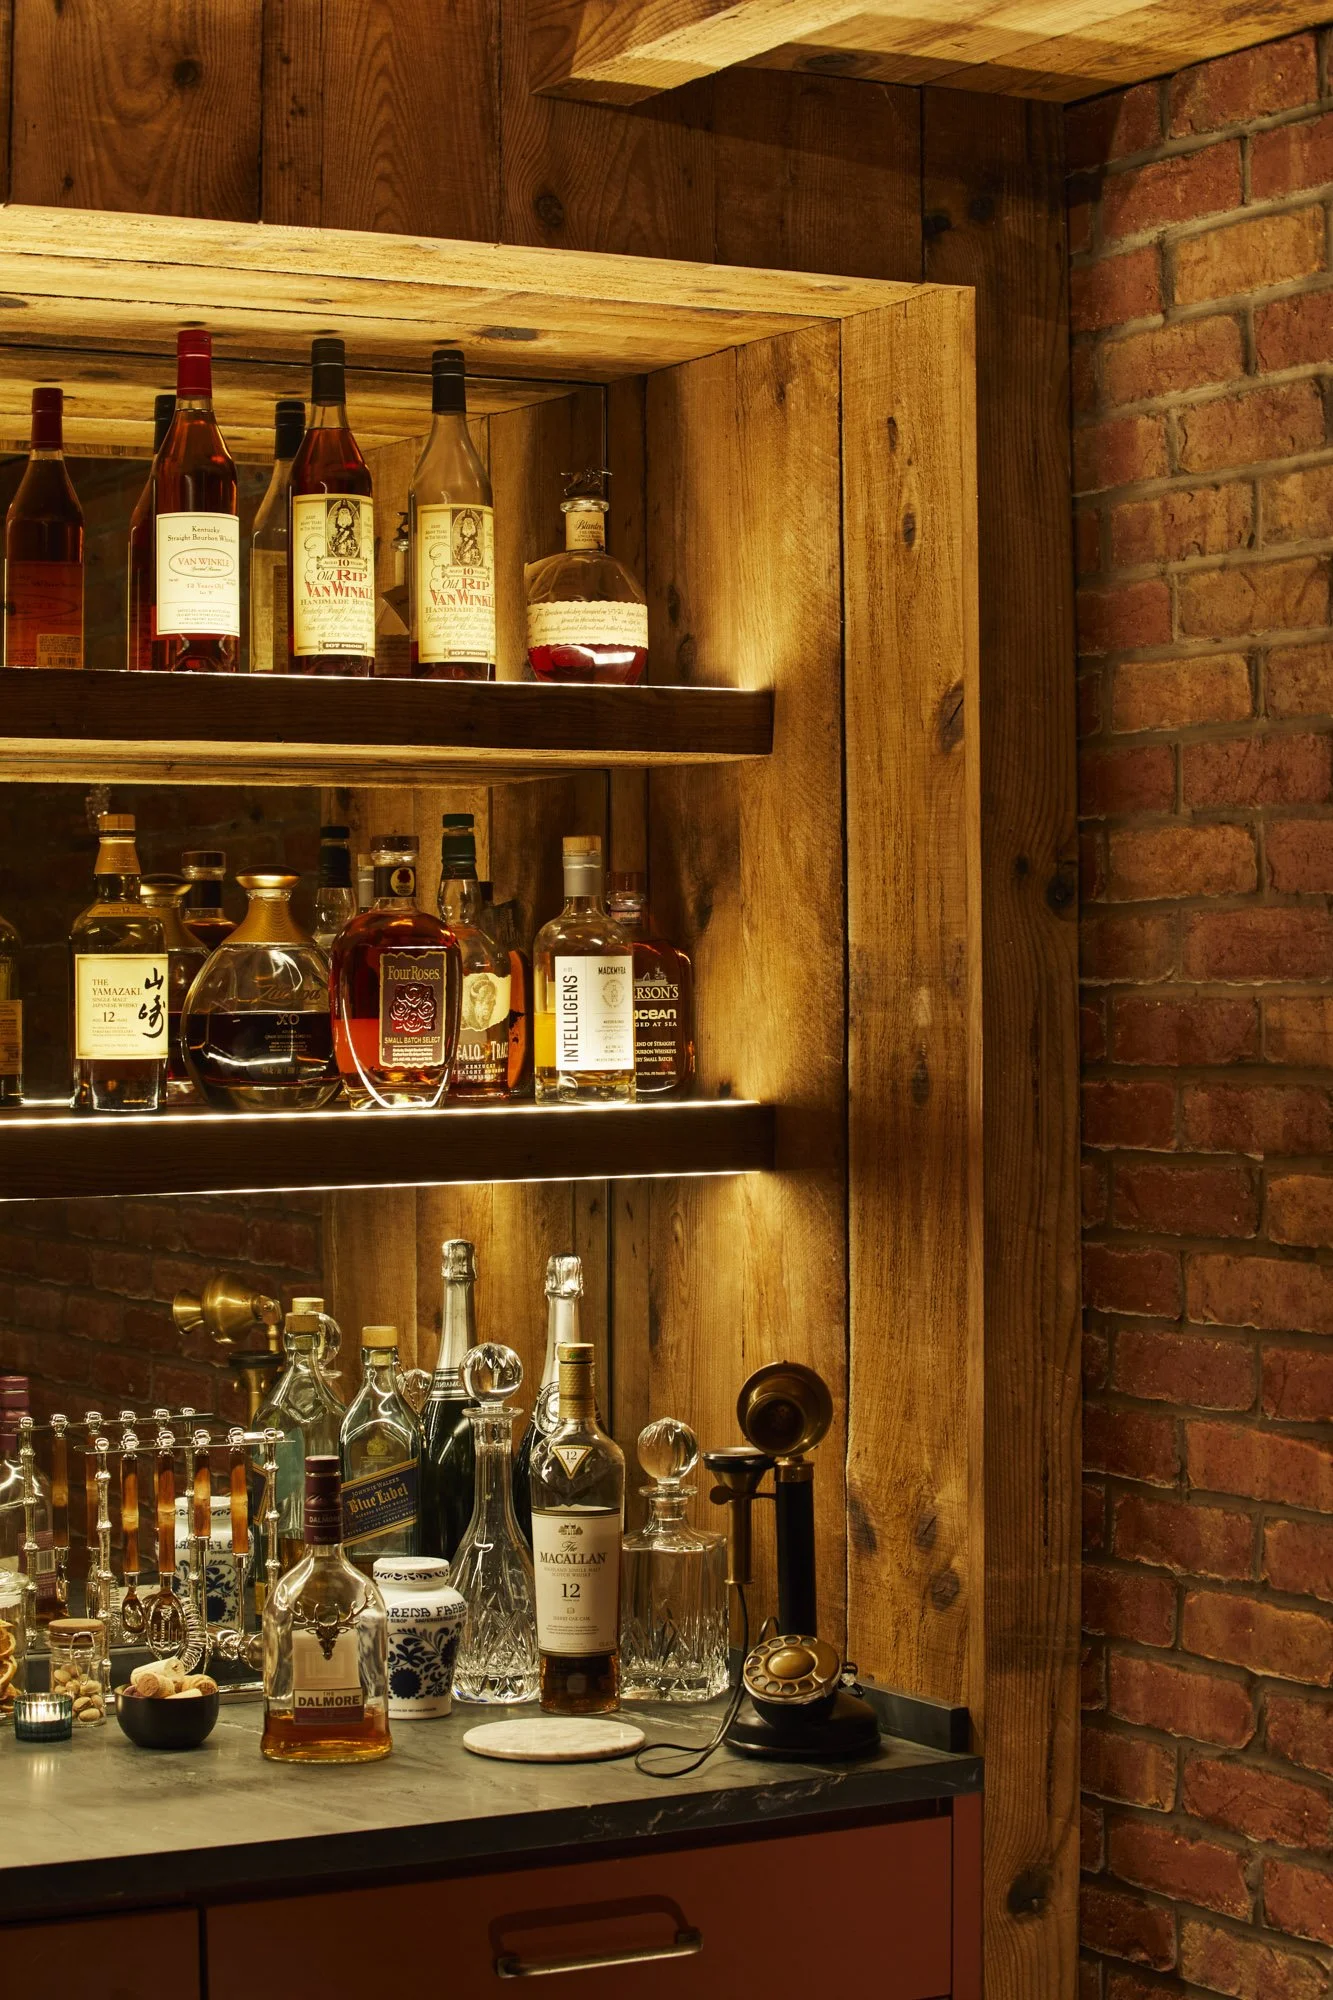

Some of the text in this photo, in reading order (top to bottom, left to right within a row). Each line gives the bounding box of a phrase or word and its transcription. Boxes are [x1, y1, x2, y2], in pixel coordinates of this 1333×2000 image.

[192, 525, 220, 533] Kentucky
[168, 534, 191, 542] Straight
[178, 558, 230, 567] VAN WINKLE
[338, 559, 350, 567] 10
[317, 569, 368, 582] Old RIP
[463, 567, 474, 576] 10
[305, 580, 331, 598] VAN
[442, 577, 491, 591] Old RIP
[429, 589, 455, 606] VAN
[425, 606, 474, 614] HANDMADE
[598, 966, 626, 975] MACKMYRA
[92, 978, 109, 986] THE
[103, 1011, 116, 1023] 12
[276, 1012, 300, 1025] XO
[562, 975, 579, 1063] INTELLIGENS
[384, 1036, 403, 1044] SMALL
[565, 1450, 577, 1461] 12
[346, 1496, 376, 1516] Blue
[374, 1482, 409, 1506] Label
[561, 1540, 578, 1553] The
[540, 1551, 608, 1565] MACALLAN
[561, 1583, 581, 1598] 12
[297, 1694, 362, 1707] DALMORE
